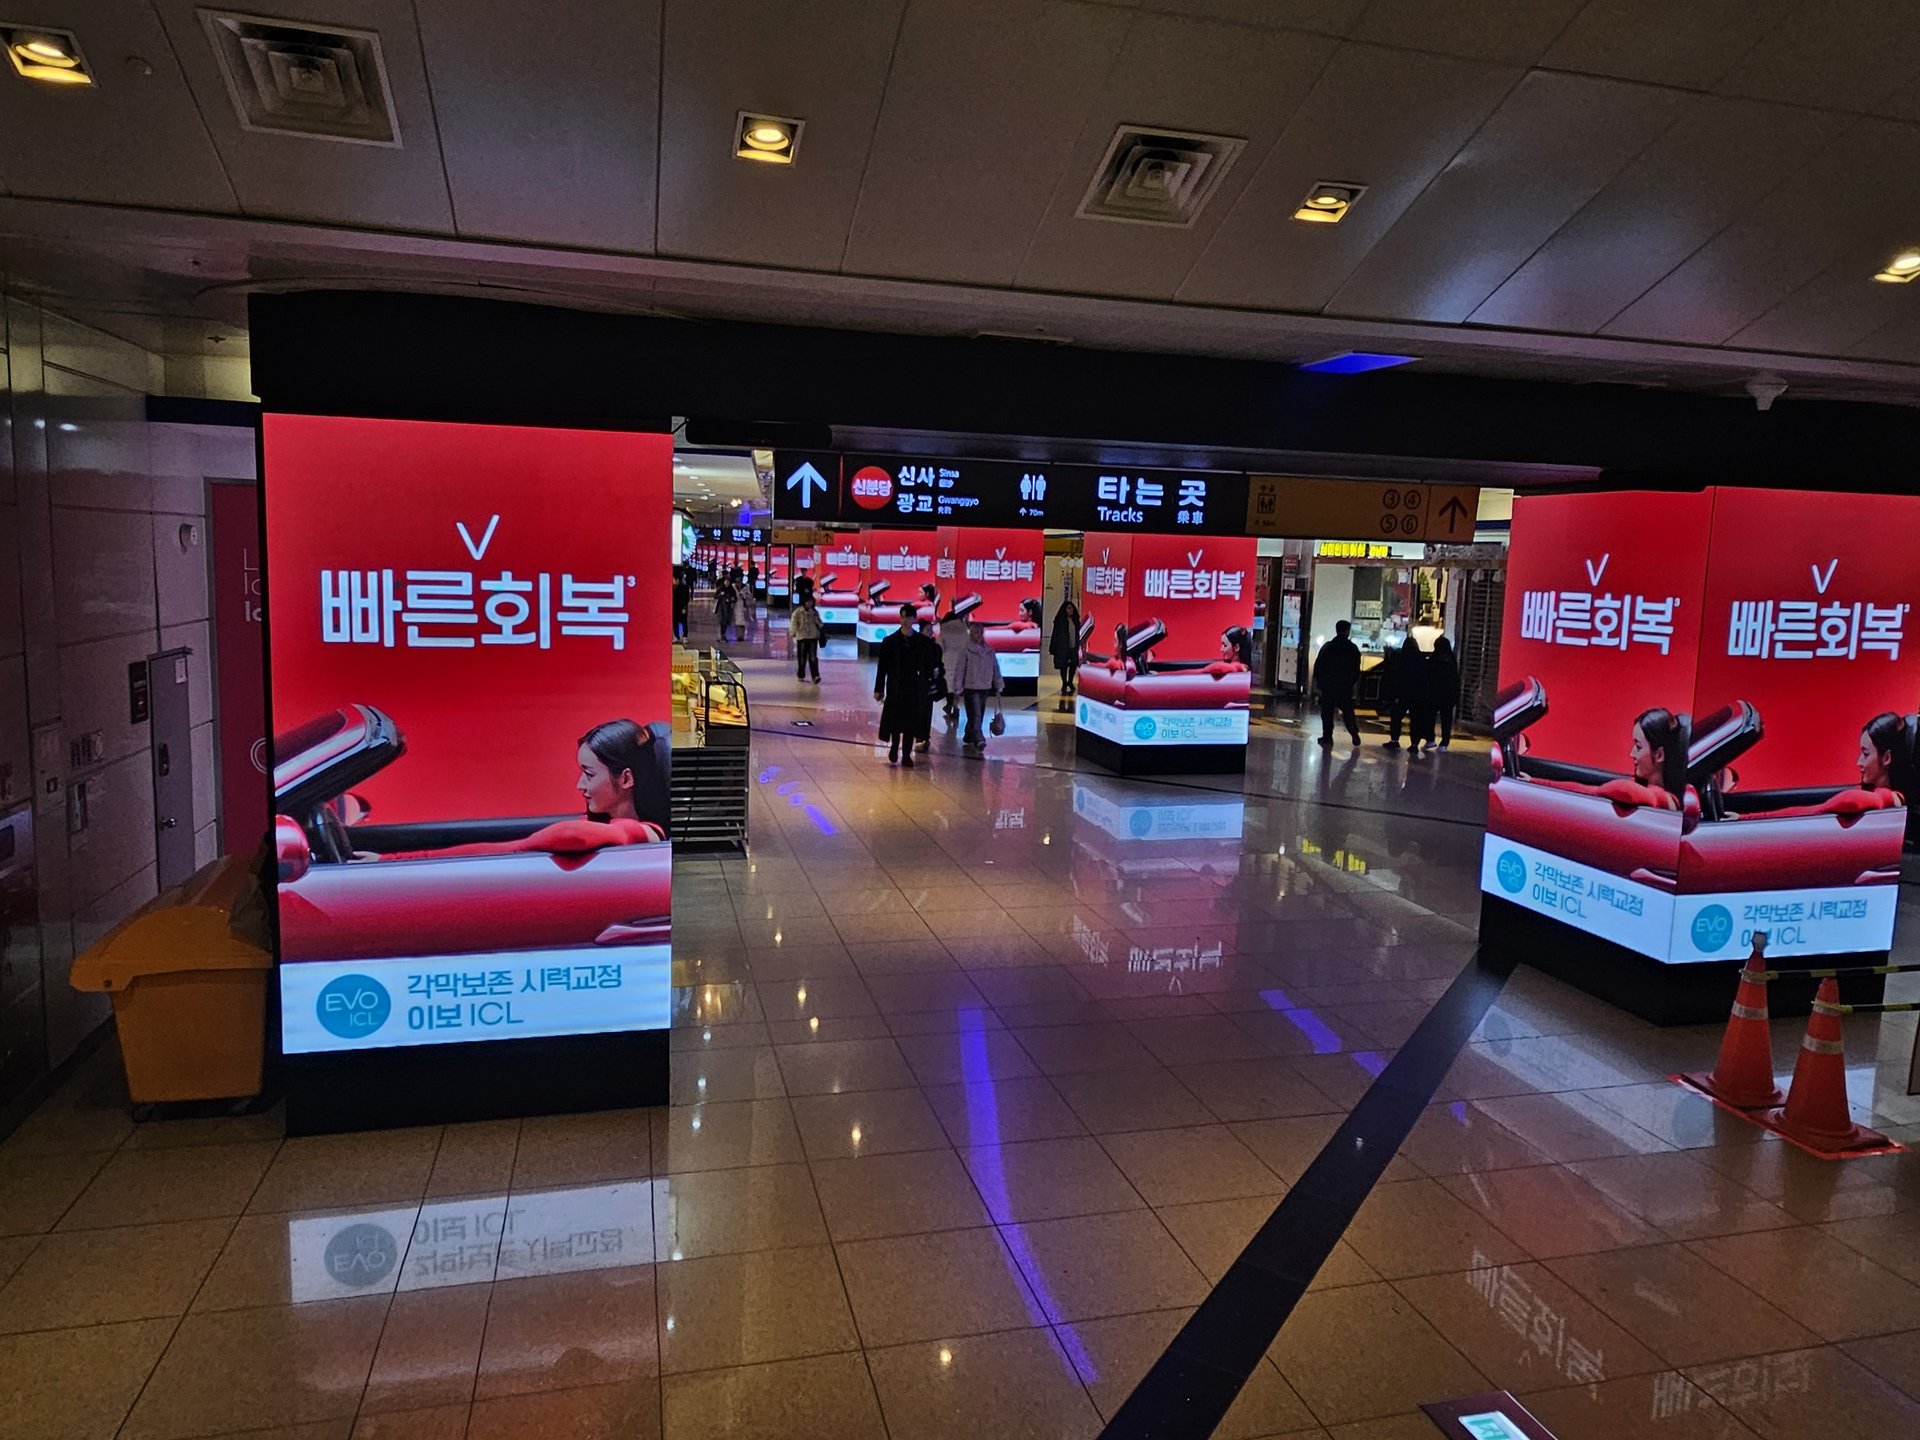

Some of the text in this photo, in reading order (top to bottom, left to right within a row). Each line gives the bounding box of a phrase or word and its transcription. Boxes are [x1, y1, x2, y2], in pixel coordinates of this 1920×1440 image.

[898, 466, 935, 487] 신사
[938, 468, 960, 479] Sinsa
[853, 479, 892, 496] 신분당
[1098, 476, 1206, 507] 타는 곳
[897, 493, 933, 513] 광교
[937, 495, 980, 507] Gwanggyo
[1097, 506, 1143, 523] Tracks
[1144, 568, 1243, 600] 빠른회복
[320, 568, 630, 651] 빠른회복
[1520, 590, 1675, 656] 빠른회복
[1727, 600, 1905, 662] 빠른회복
[1162, 728, 1179, 738] 이보
[1500, 858, 1522, 878] EVO
[1535, 861, 1644, 917] 각막보존 시력교정
[1532, 885, 1587, 919] 이보 ICL
[1743, 900, 1868, 924] 각막보존 시력교정
[1697, 917, 1728, 933] EVO
[1776, 926, 1807, 946] ICL
[407, 964, 623, 999] 각막보존 시력교정
[325, 991, 378, 1011] EVO
[349, 1011, 378, 1027] ICL
[408, 1001, 524, 1030] 이보 ICL
